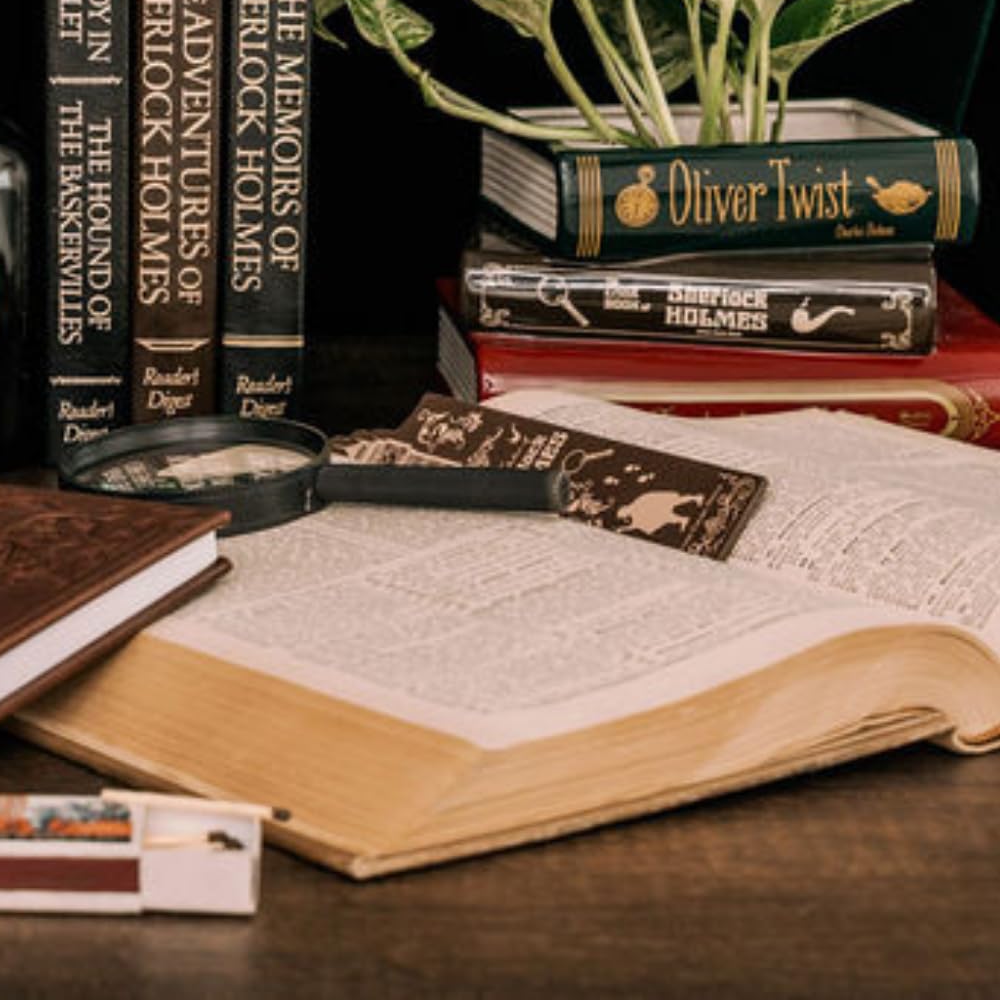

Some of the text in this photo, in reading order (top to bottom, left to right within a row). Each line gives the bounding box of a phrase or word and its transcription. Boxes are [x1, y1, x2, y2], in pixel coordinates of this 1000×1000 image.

[87, 32, 112, 64] IN
[177, 12, 214, 260] ADVENTURES
[271, 53, 308, 217] MEMOIRS
[57, 100, 84, 345] THE BASKERVILLES
[87, 117, 113, 332] THE HOUND OF
[137, 155, 173, 306] HOLMES
[230, 147, 266, 294] HOLMES
[669, 156, 853, 227] Oliver Twist
[177, 264, 203, 306] OF
[268, 234, 300, 273] OF
[664, 305, 768, 332] HOLMES
[146, 390, 194, 416] Digest
